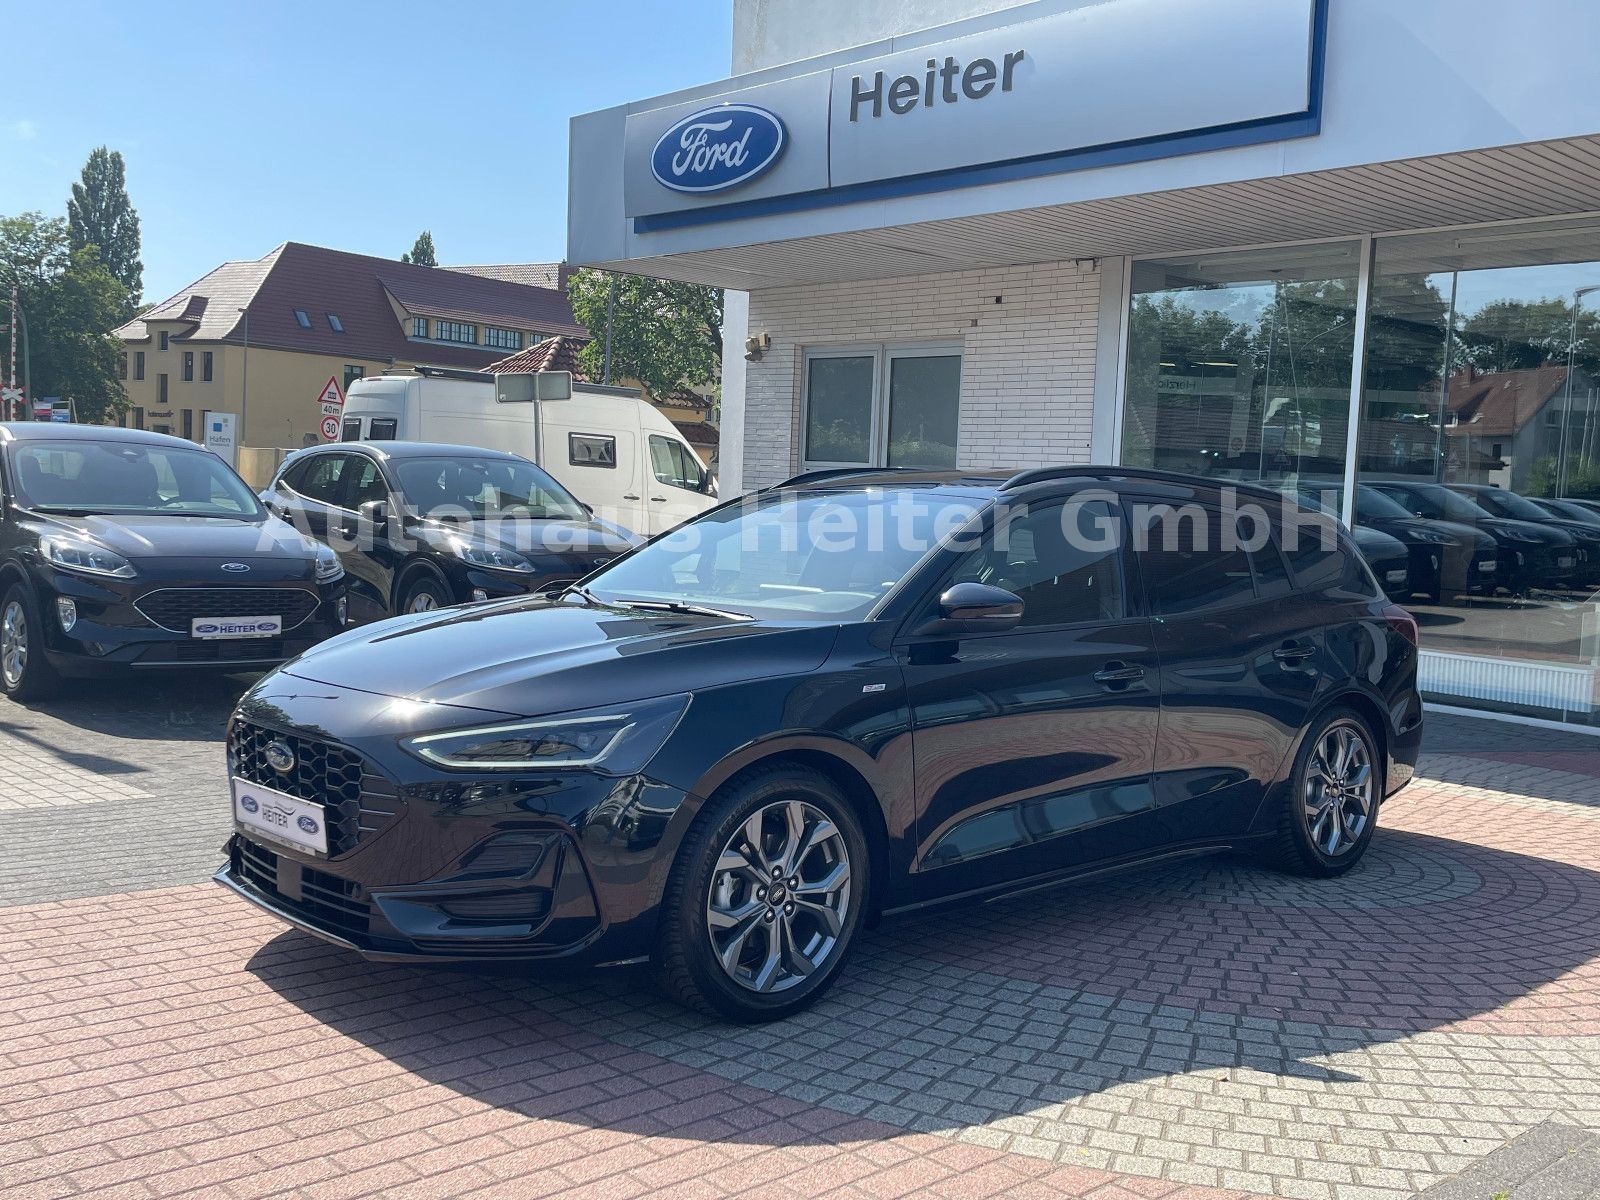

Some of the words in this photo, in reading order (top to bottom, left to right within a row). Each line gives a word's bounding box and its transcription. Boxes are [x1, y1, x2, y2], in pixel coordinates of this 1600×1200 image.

[848, 49, 1025, 122] Heiter
[671, 119, 751, 177] Ford
[325, 422, 336, 434] 30
[209, 435, 231, 443] Hafen
[220, 625, 256, 633] HEITER
[262, 808, 288, 828] HEITER
